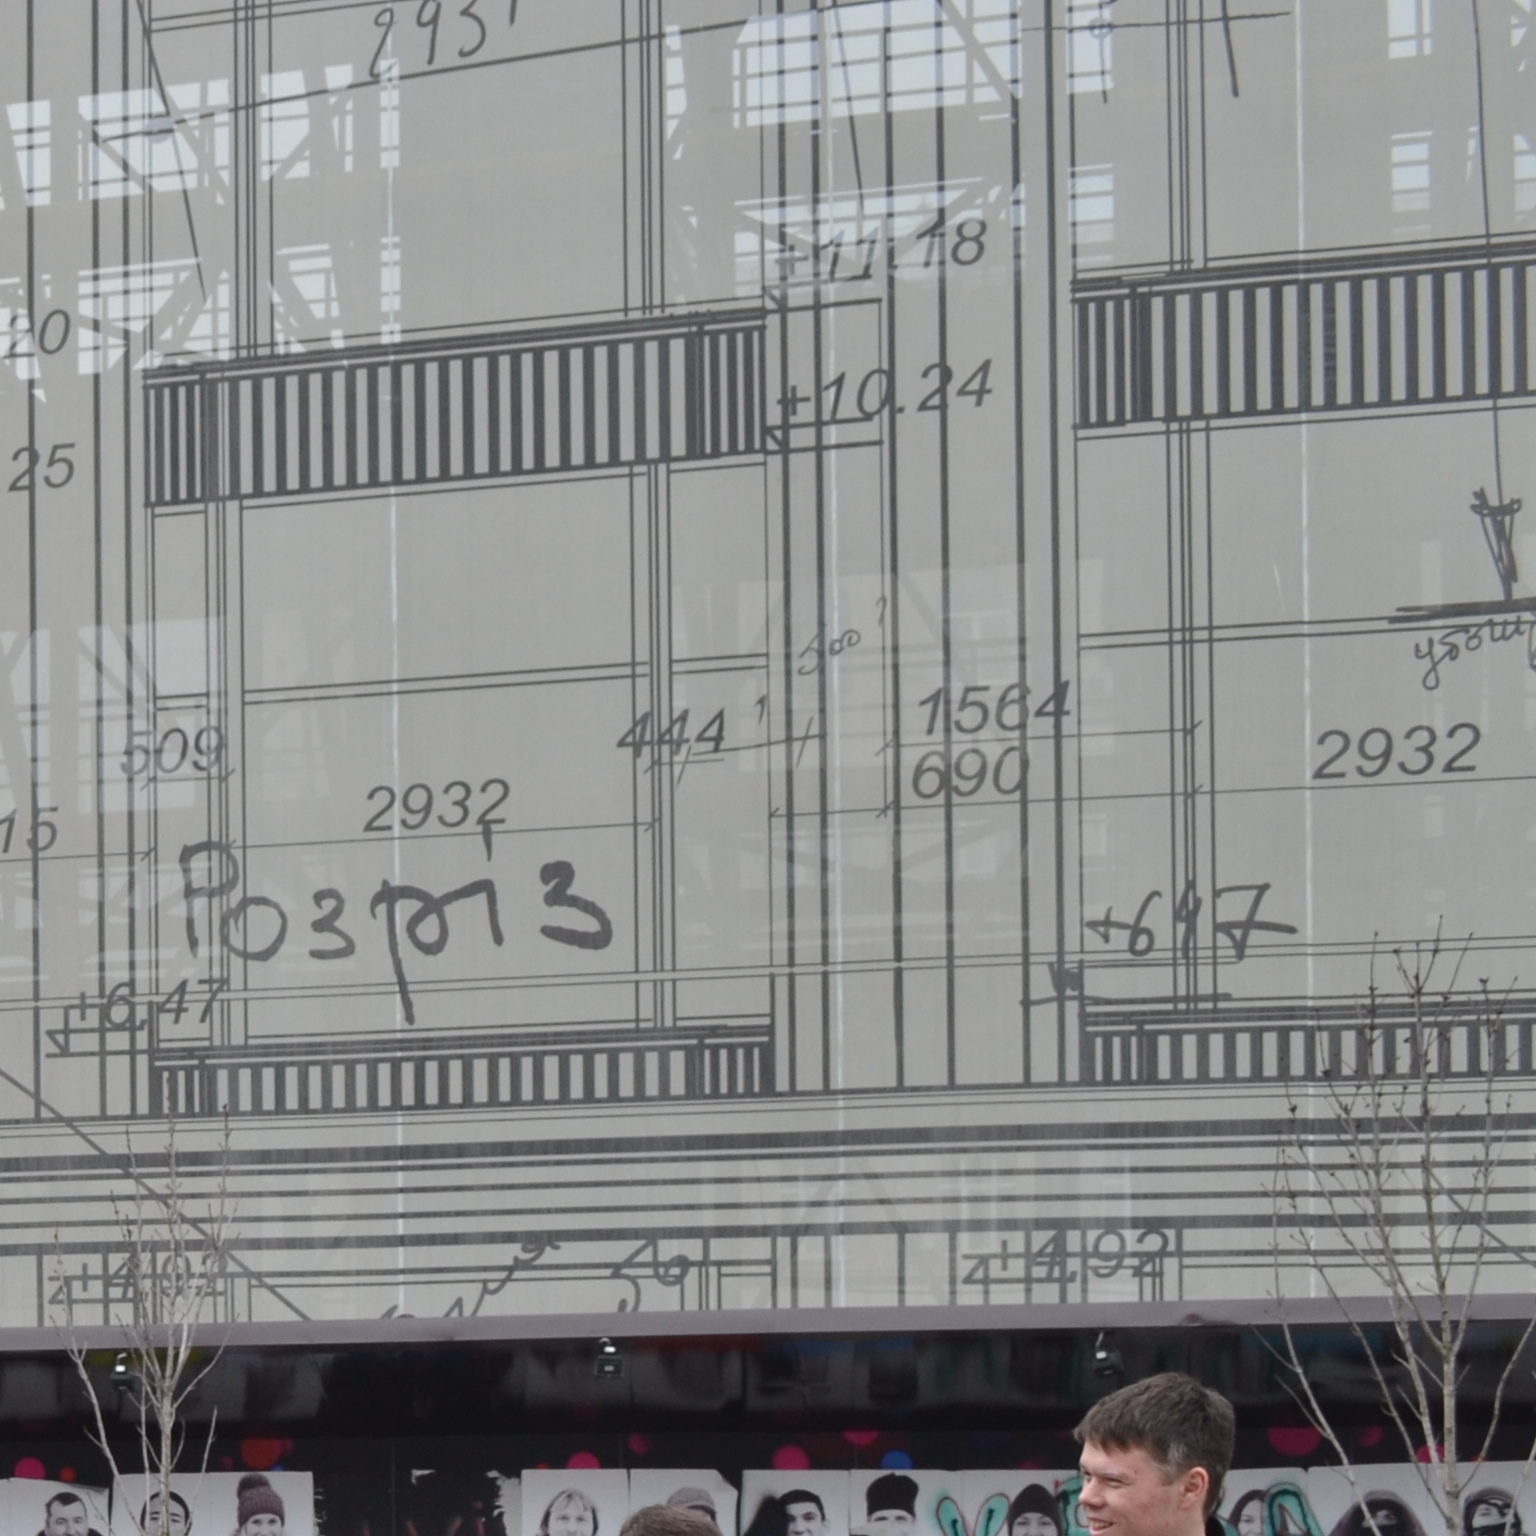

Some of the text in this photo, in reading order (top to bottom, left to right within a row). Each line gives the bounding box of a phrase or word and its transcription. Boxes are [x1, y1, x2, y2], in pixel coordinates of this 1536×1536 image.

[776, 358, 993, 421] +10.24
[918, 681, 1072, 738] 1564
[120, 724, 224, 776] 509
[911, 746, 1030, 800] 690
[1312, 721, 1482, 781] 2932
[362, 778, 512, 833] 2932
